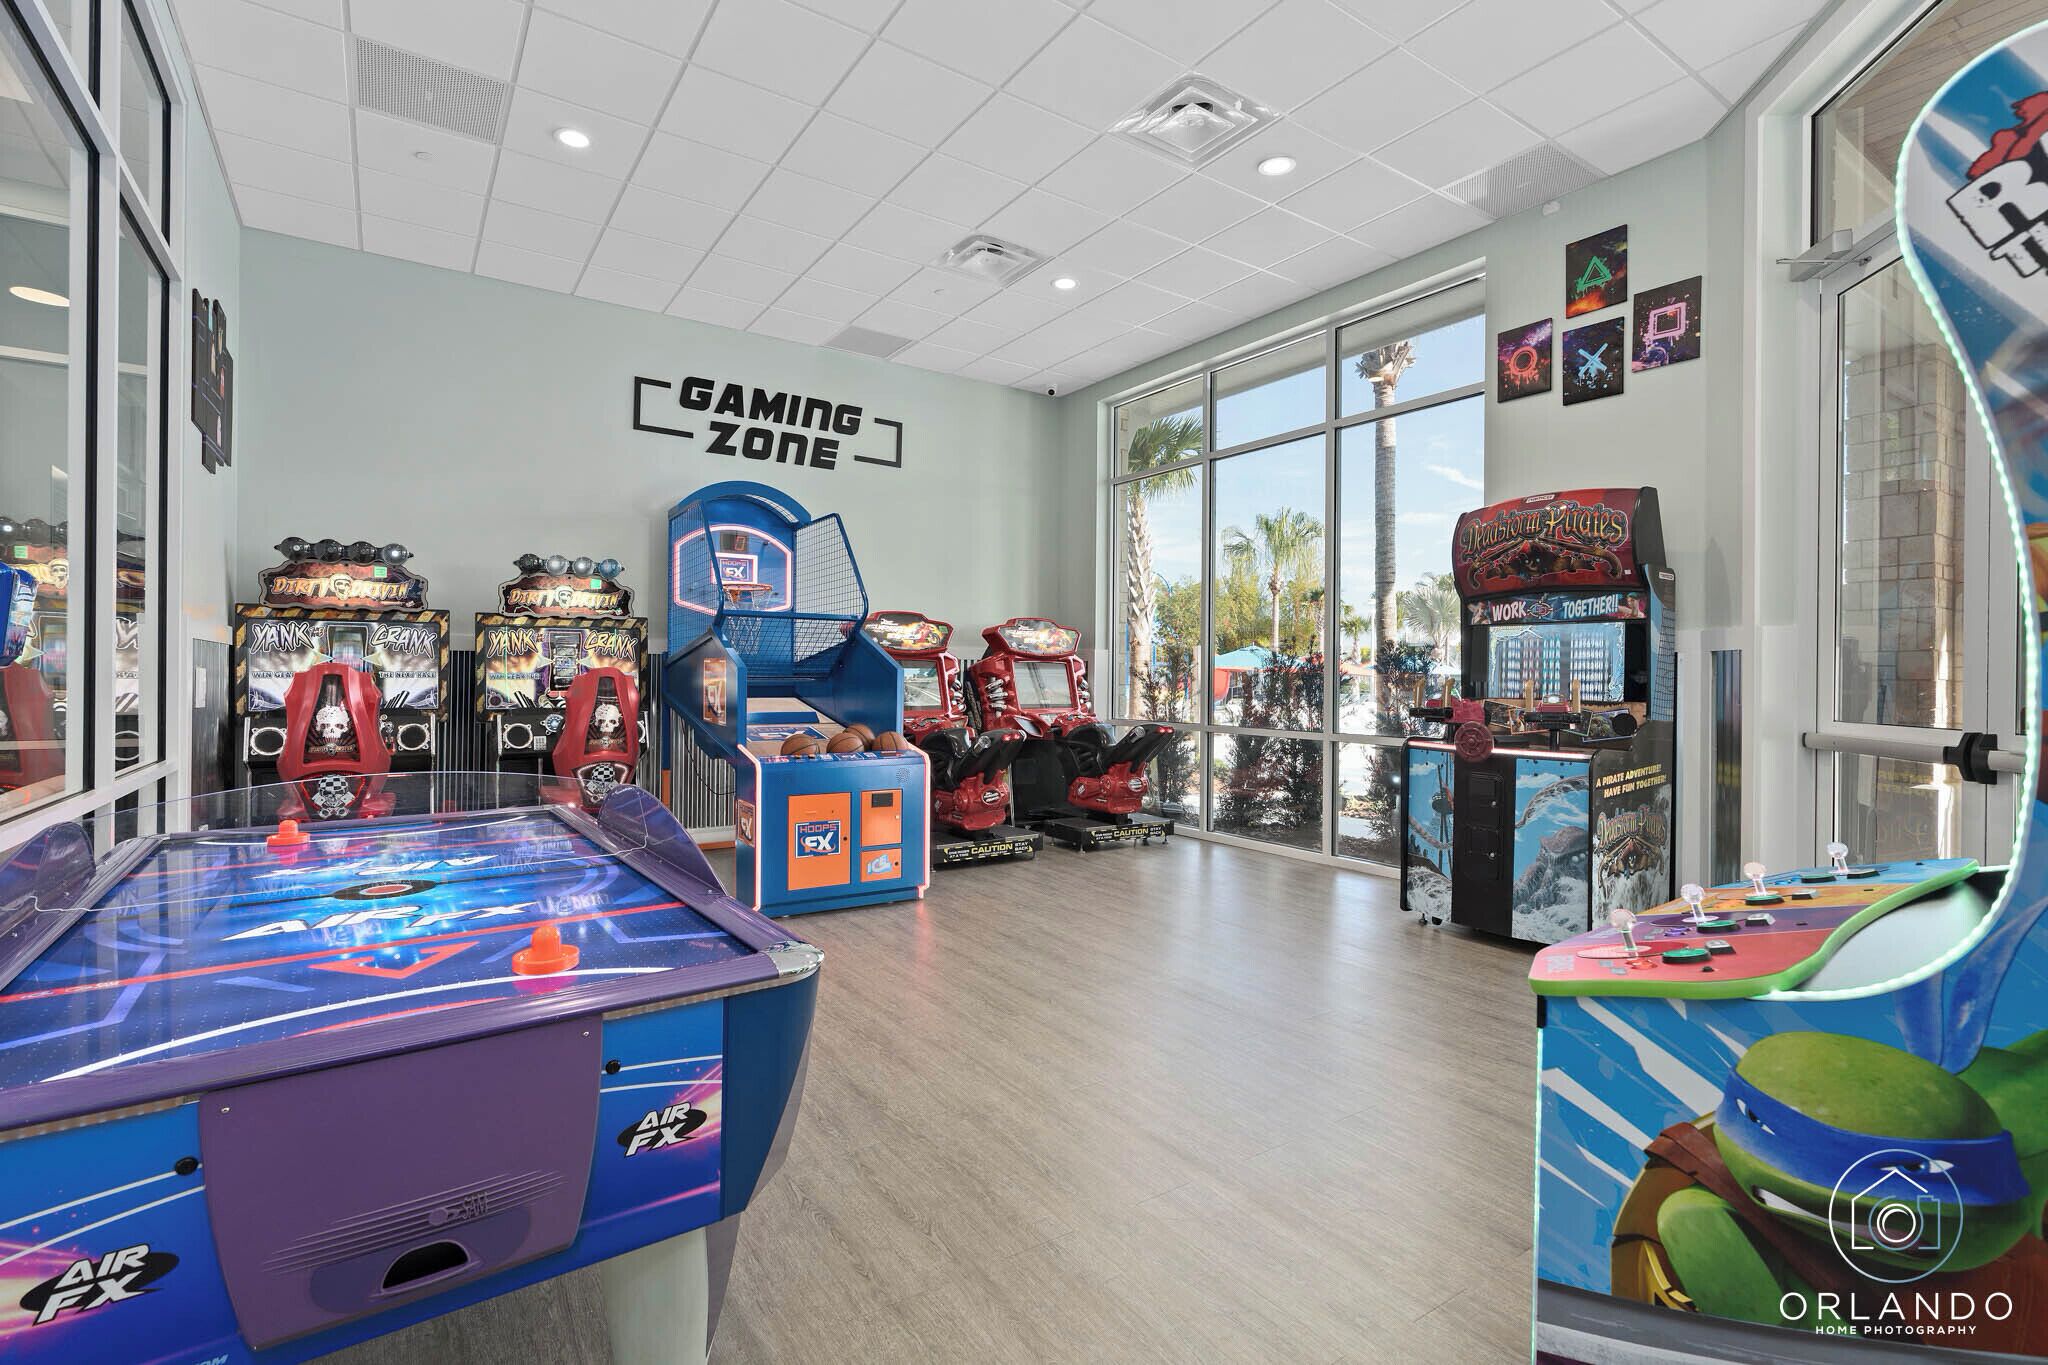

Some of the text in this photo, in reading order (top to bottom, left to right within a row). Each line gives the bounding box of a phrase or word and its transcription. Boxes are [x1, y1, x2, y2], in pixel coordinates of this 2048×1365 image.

[679, 376, 863, 436] GAMING
[705, 421, 840, 470] ZONE
[1467, 503, 1623, 553] Deadstorm Pirates
[271, 576, 330, 598] DIRTY
[1492, 594, 1619, 622] WORK TOGETHER!!
[250, 621, 317, 655] YANK
[370, 624, 438, 660] CRANK
[487, 627, 539, 658] YANK
[583, 630, 638, 662] CRANK
[1595, 777, 1602, 788] A
[1602, 772, 1625, 786] PIRATE
[1603, 785, 1622, 798] HAVE
[1622, 782, 1635, 793] FUN
[799, 823, 838, 833] HOOPS
[804, 831, 835, 853] FX
[1113, 827, 1149, 837] CAUTION
[971, 843, 1013, 854] CAUTION
[866, 853, 894, 875] ICE
[218, 905, 425, 941] AIR
[406, 902, 538, 929] FX
[636, 1102, 691, 1132] AIR
[624, 1121, 688, 1157] FX
[54, 1244, 149, 1289] AIR
[33, 1270, 146, 1325] FX
